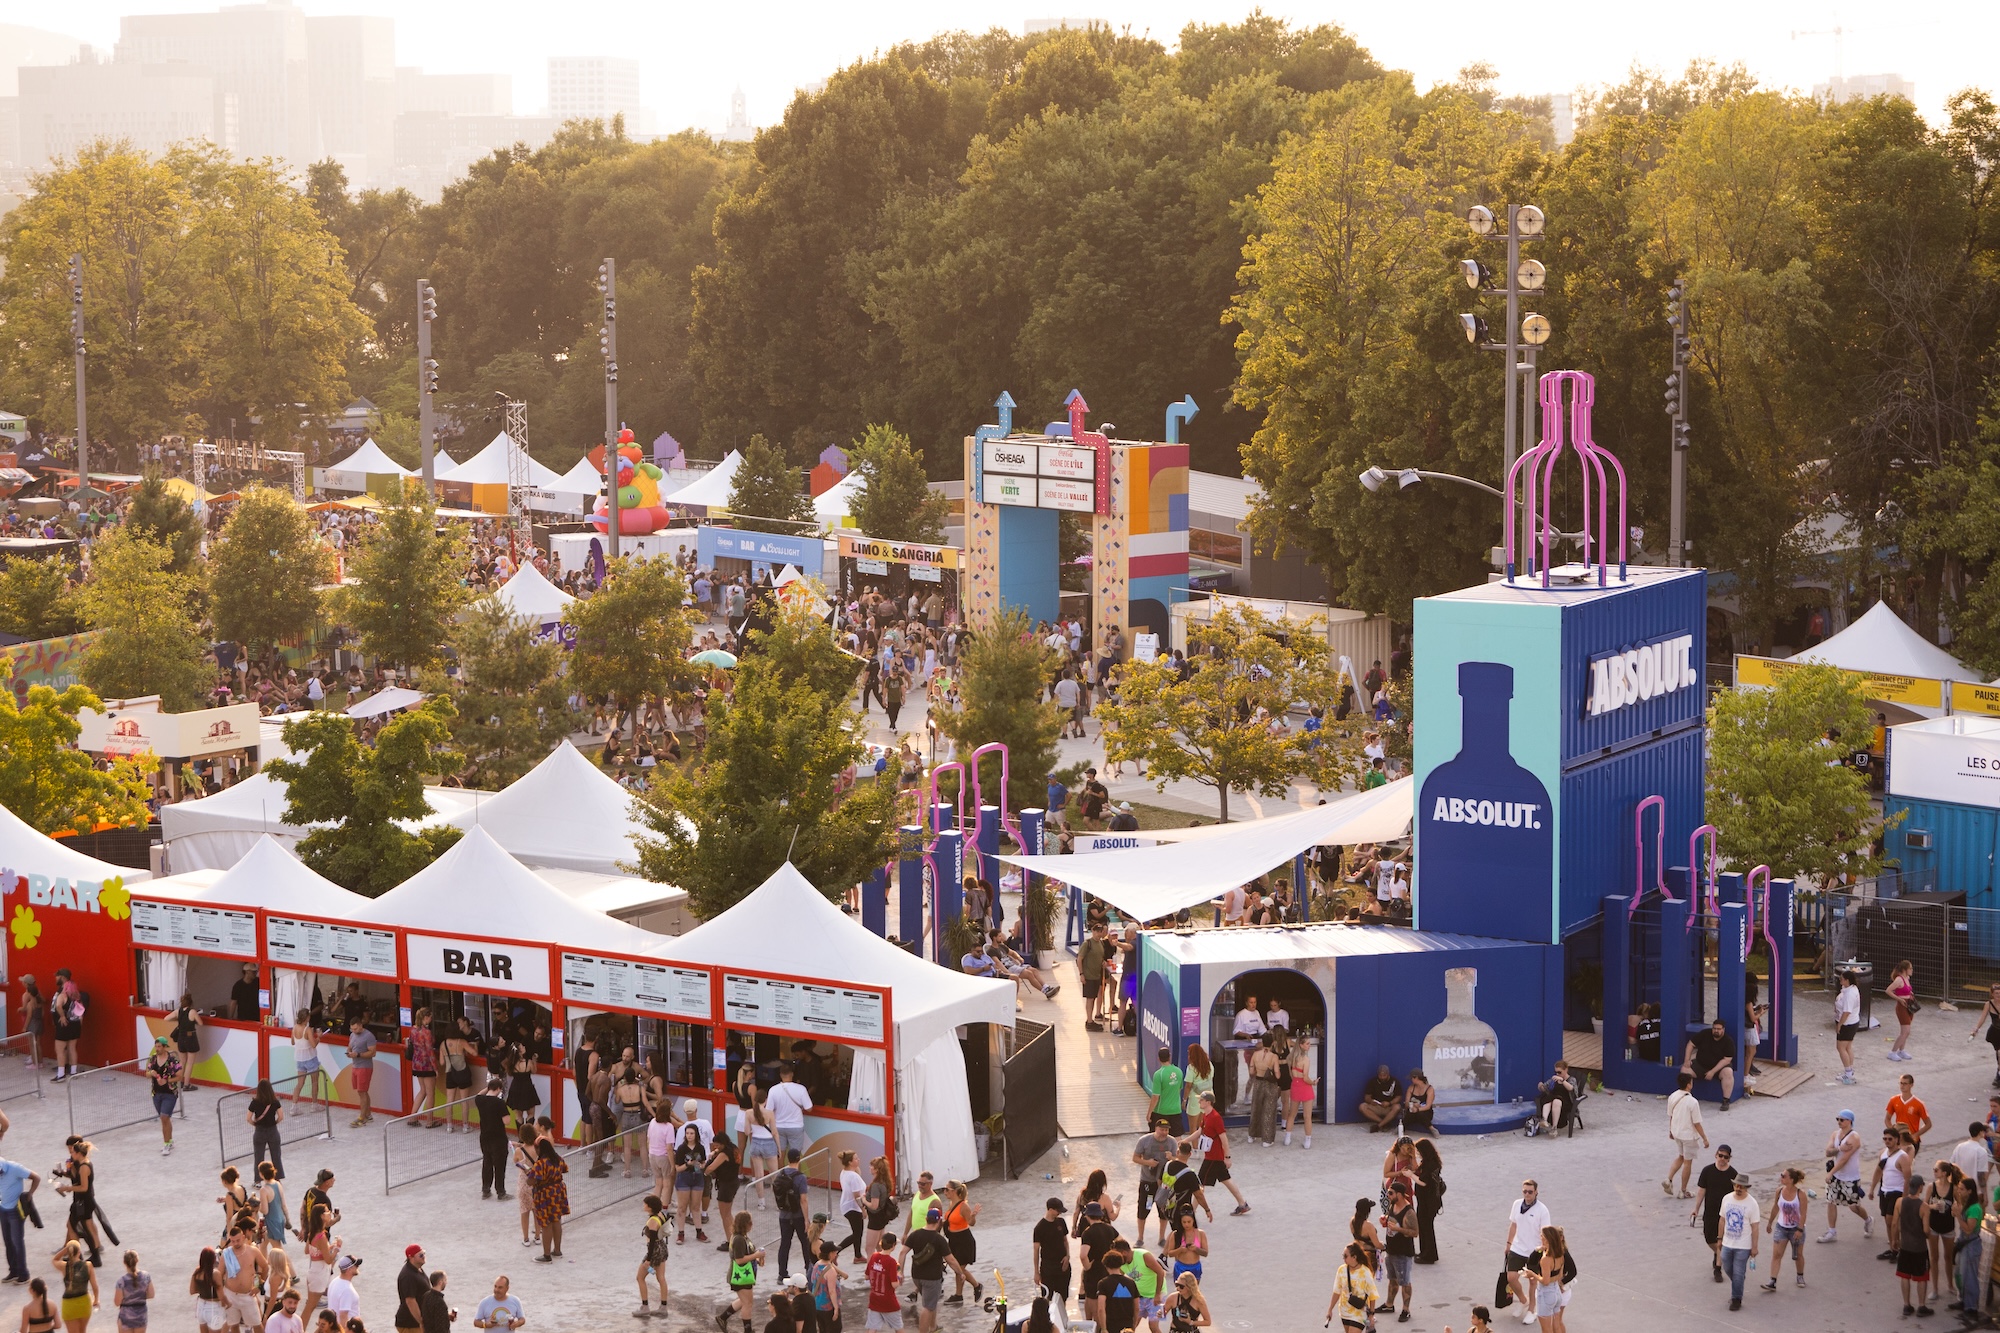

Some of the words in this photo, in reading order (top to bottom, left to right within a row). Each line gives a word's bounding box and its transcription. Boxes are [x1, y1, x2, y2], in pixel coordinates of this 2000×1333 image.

[995, 453, 1026, 465] OSHEAGA
[1000, 486, 1020, 496] VERTE
[1069, 493, 1088, 501] VALLÉE
[740, 540, 755, 552] BAR
[851, 542, 880, 556] LIMO
[882, 545, 889, 557] &
[892, 547, 944, 564] SANGRIA
[1591, 634, 1697, 717] ABSOLUT.
[1896, 677, 1916, 686] CLIENT
[1974, 689, 1999, 702] PAUSE
[1967, 756, 1987, 769] LES
[1092, 838, 1139, 850] ABSOLUT.
[28, 873, 100, 914] BAR
[443, 948, 513, 980] BAR
[1143, 1008, 1170, 1047] ABSOLUT.
